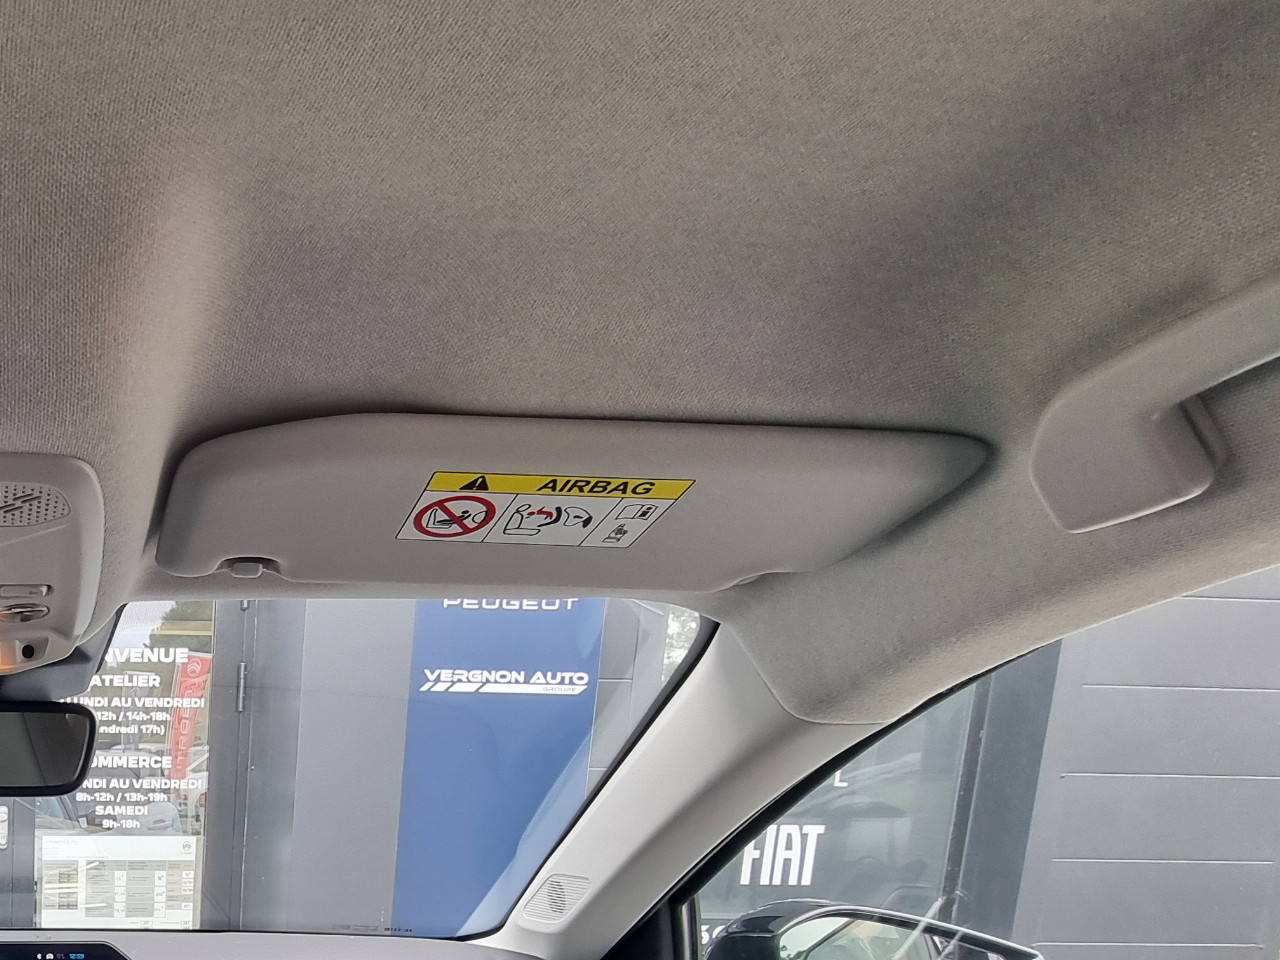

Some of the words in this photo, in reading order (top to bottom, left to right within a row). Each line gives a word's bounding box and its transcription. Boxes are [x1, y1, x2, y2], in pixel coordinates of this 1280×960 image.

[537, 478, 656, 495] AIRBAG
[443, 598, 579, 610] PEUGEOT
[90, 674, 161, 687] ATELIER
[423, 669, 525, 683] VERGNON
[530, 671, 589, 685] AUTO
[111, 697, 131, 707] AU
[135, 697, 205, 708] VENDREDI
[126, 711, 171, 721] 14h-18h
[140, 724, 165, 735] 17h)
[109, 778, 130, 789] AU
[133, 778, 201, 789] VENDREDI
[76, 793, 114, 802] 8h-12h
[124, 793, 168, 802] 13h-19h
[95, 805, 148, 815] SAMEDI
[102, 819, 140, 829] 9h-18h
[740, 825, 826, 886] FIAT
